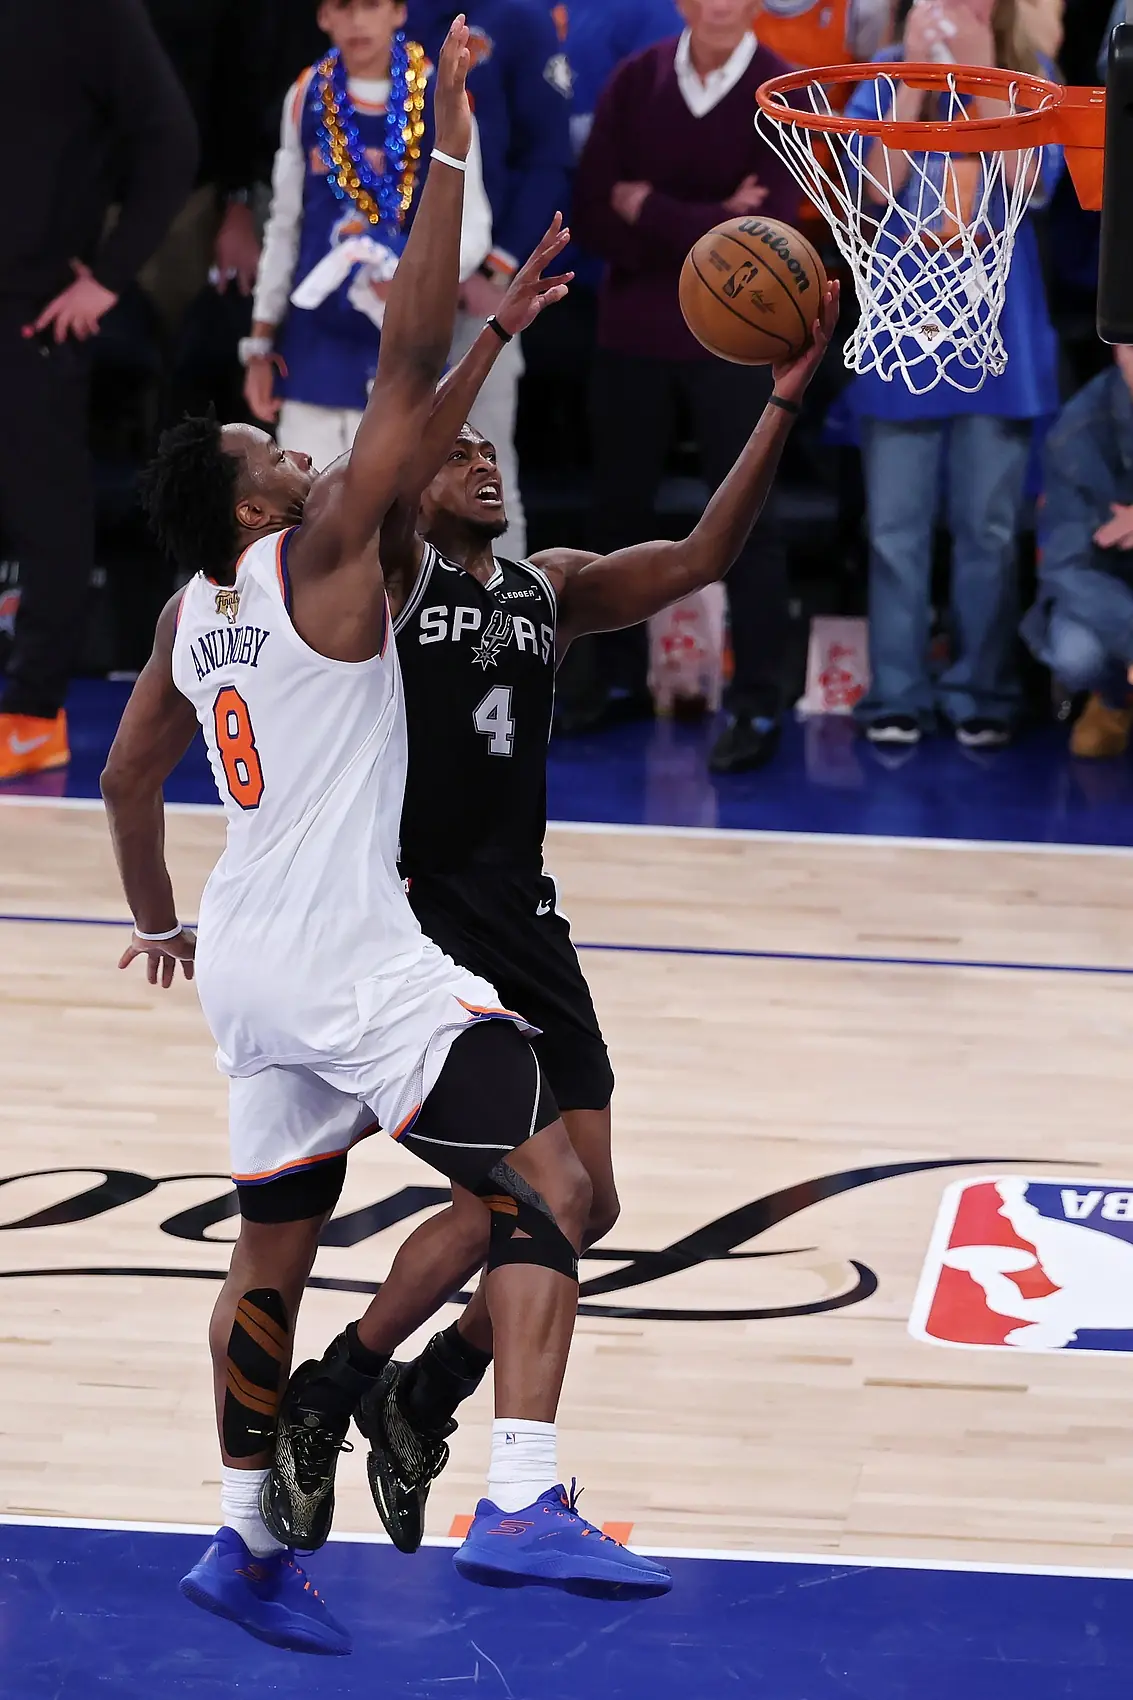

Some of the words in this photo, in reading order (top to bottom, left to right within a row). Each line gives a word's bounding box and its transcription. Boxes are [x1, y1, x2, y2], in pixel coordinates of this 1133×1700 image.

[738, 219, 811, 294] Wilson
[500, 589, 535, 600] LEDGER
[418, 604, 554, 669] SPURS
[212, 685, 265, 810] 8
[472, 684, 516, 758] 4
